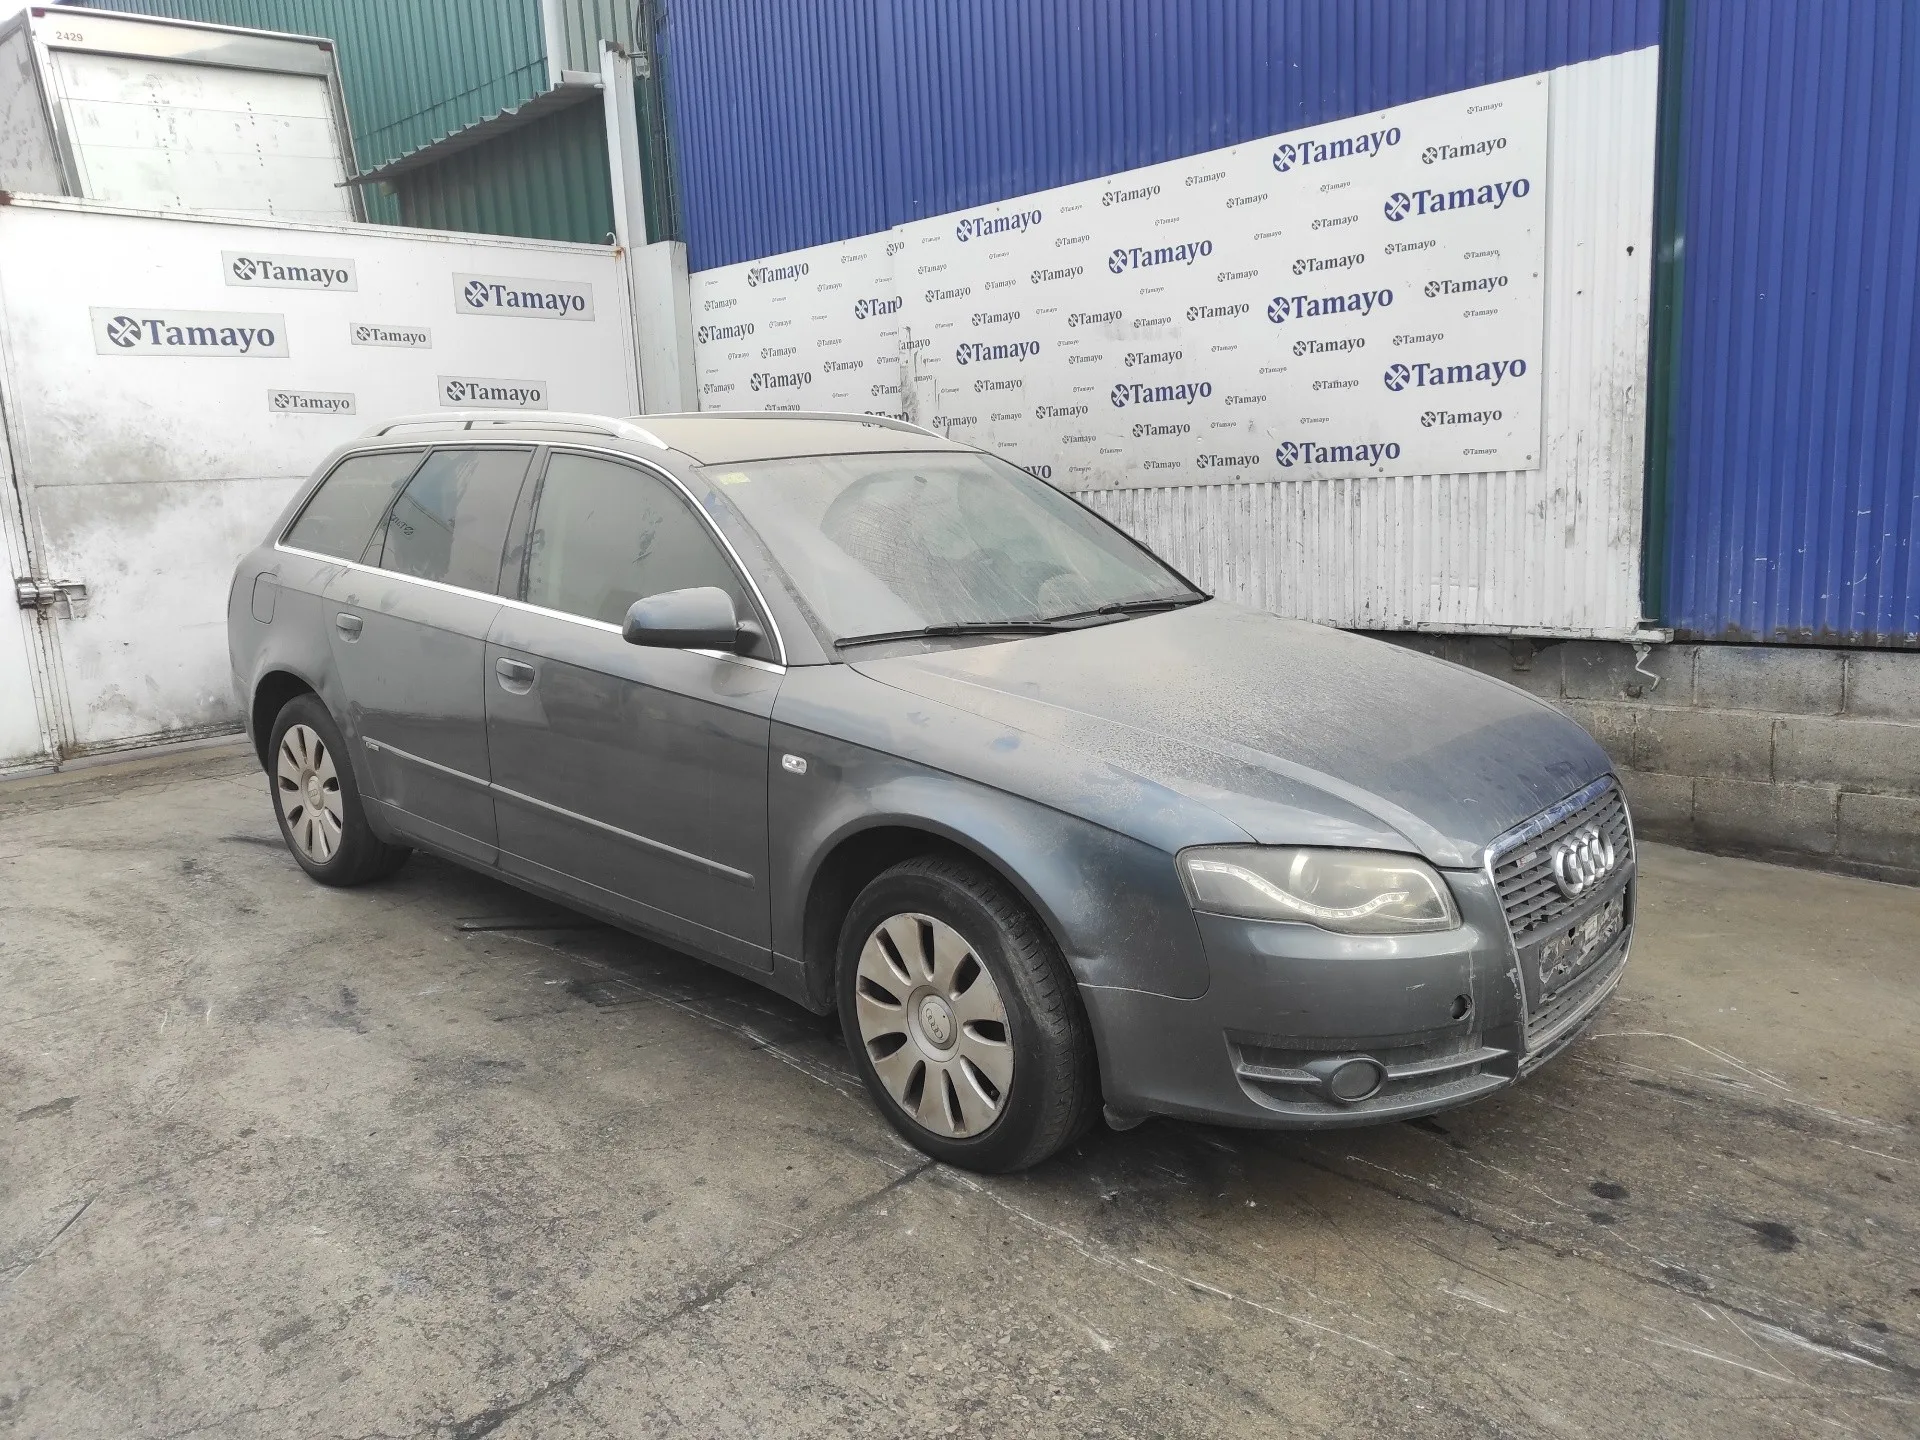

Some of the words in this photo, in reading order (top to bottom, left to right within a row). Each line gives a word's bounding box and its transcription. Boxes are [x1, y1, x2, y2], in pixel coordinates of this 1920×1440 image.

[56, 31, 83, 42] 2429
[1474, 102, 1503, 113] Tamayo
[1298, 127, 1401, 166] Tamayo
[1438, 137, 1507, 161] Tamayo
[1193, 171, 1226, 185] Tamayo
[1326, 181, 1351, 191] Tamayo
[1113, 184, 1161, 204] Tamayo
[1234, 192, 1268, 207] Tamayo
[1412, 178, 1530, 216] Tamayo
[972, 209, 1042, 238] Tamayo
[1320, 214, 1359, 229] Tamayo
[1061, 234, 1090, 246] Tamayo
[1395, 239, 1436, 253] Tamayo
[1129, 240, 1212, 269] Tamayo
[1470, 249, 1499, 259] Tamayo
[924, 264, 947, 274] Tamayo
[1306, 253, 1365, 272] Tamayo
[257, 259, 349, 287] Tamayo
[760, 263, 809, 283] Tamayo
[1040, 265, 1084, 282] Tamayo
[1224, 269, 1258, 282] Tamayo
[990, 279, 1016, 289] Tamayo
[1441, 275, 1508, 295] Tamayo
[934, 286, 971, 301] Tamayo
[490, 284, 586, 319] Tamayo
[711, 299, 737, 310] Tamayo
[1291, 289, 1393, 319] Tamayo
[980, 310, 1020, 325] Tamayo
[1078, 310, 1122, 325] Tamayo
[1199, 303, 1249, 319] Tamayo
[1470, 308, 1498, 318] Tamayo
[1140, 316, 1171, 328] Tamayo
[142, 319, 276, 354] Tamayo
[370, 328, 427, 346] Tamayo
[709, 323, 755, 341] Tamayo
[1403, 332, 1444, 345] Tamayo
[768, 347, 797, 358] Tamayo
[972, 339, 1040, 361] Tamayo
[1306, 337, 1365, 355] Tamayo
[1075, 353, 1103, 364] Tamayo
[1136, 350, 1182, 365] Tamayo
[831, 360, 863, 372] Tamayo
[1412, 359, 1526, 387] Tamayo
[762, 371, 811, 389] Tamayo
[983, 379, 1022, 391] Tamayo
[1320, 379, 1359, 391] Tamayo
[466, 382, 541, 405] Tamayo
[711, 383, 735, 393] Tamayo
[1130, 382, 1212, 405] Tamayo
[290, 395, 350, 413] Tamayo
[1233, 395, 1267, 405] Tamayo
[997, 413, 1022, 421] Tamayo
[1045, 404, 1088, 418] Tamayo
[1437, 410, 1502, 426] Tamayo
[941, 416, 977, 428] Tamayo
[1144, 423, 1190, 437] Tamayo
[1069, 434, 1096, 443] Tamayo
[1299, 441, 1401, 467] Tamayo
[1470, 448, 1497, 457] Tamayo
[1150, 461, 1181, 470] Tamayo
[1209, 454, 1260, 468] Tamayo
